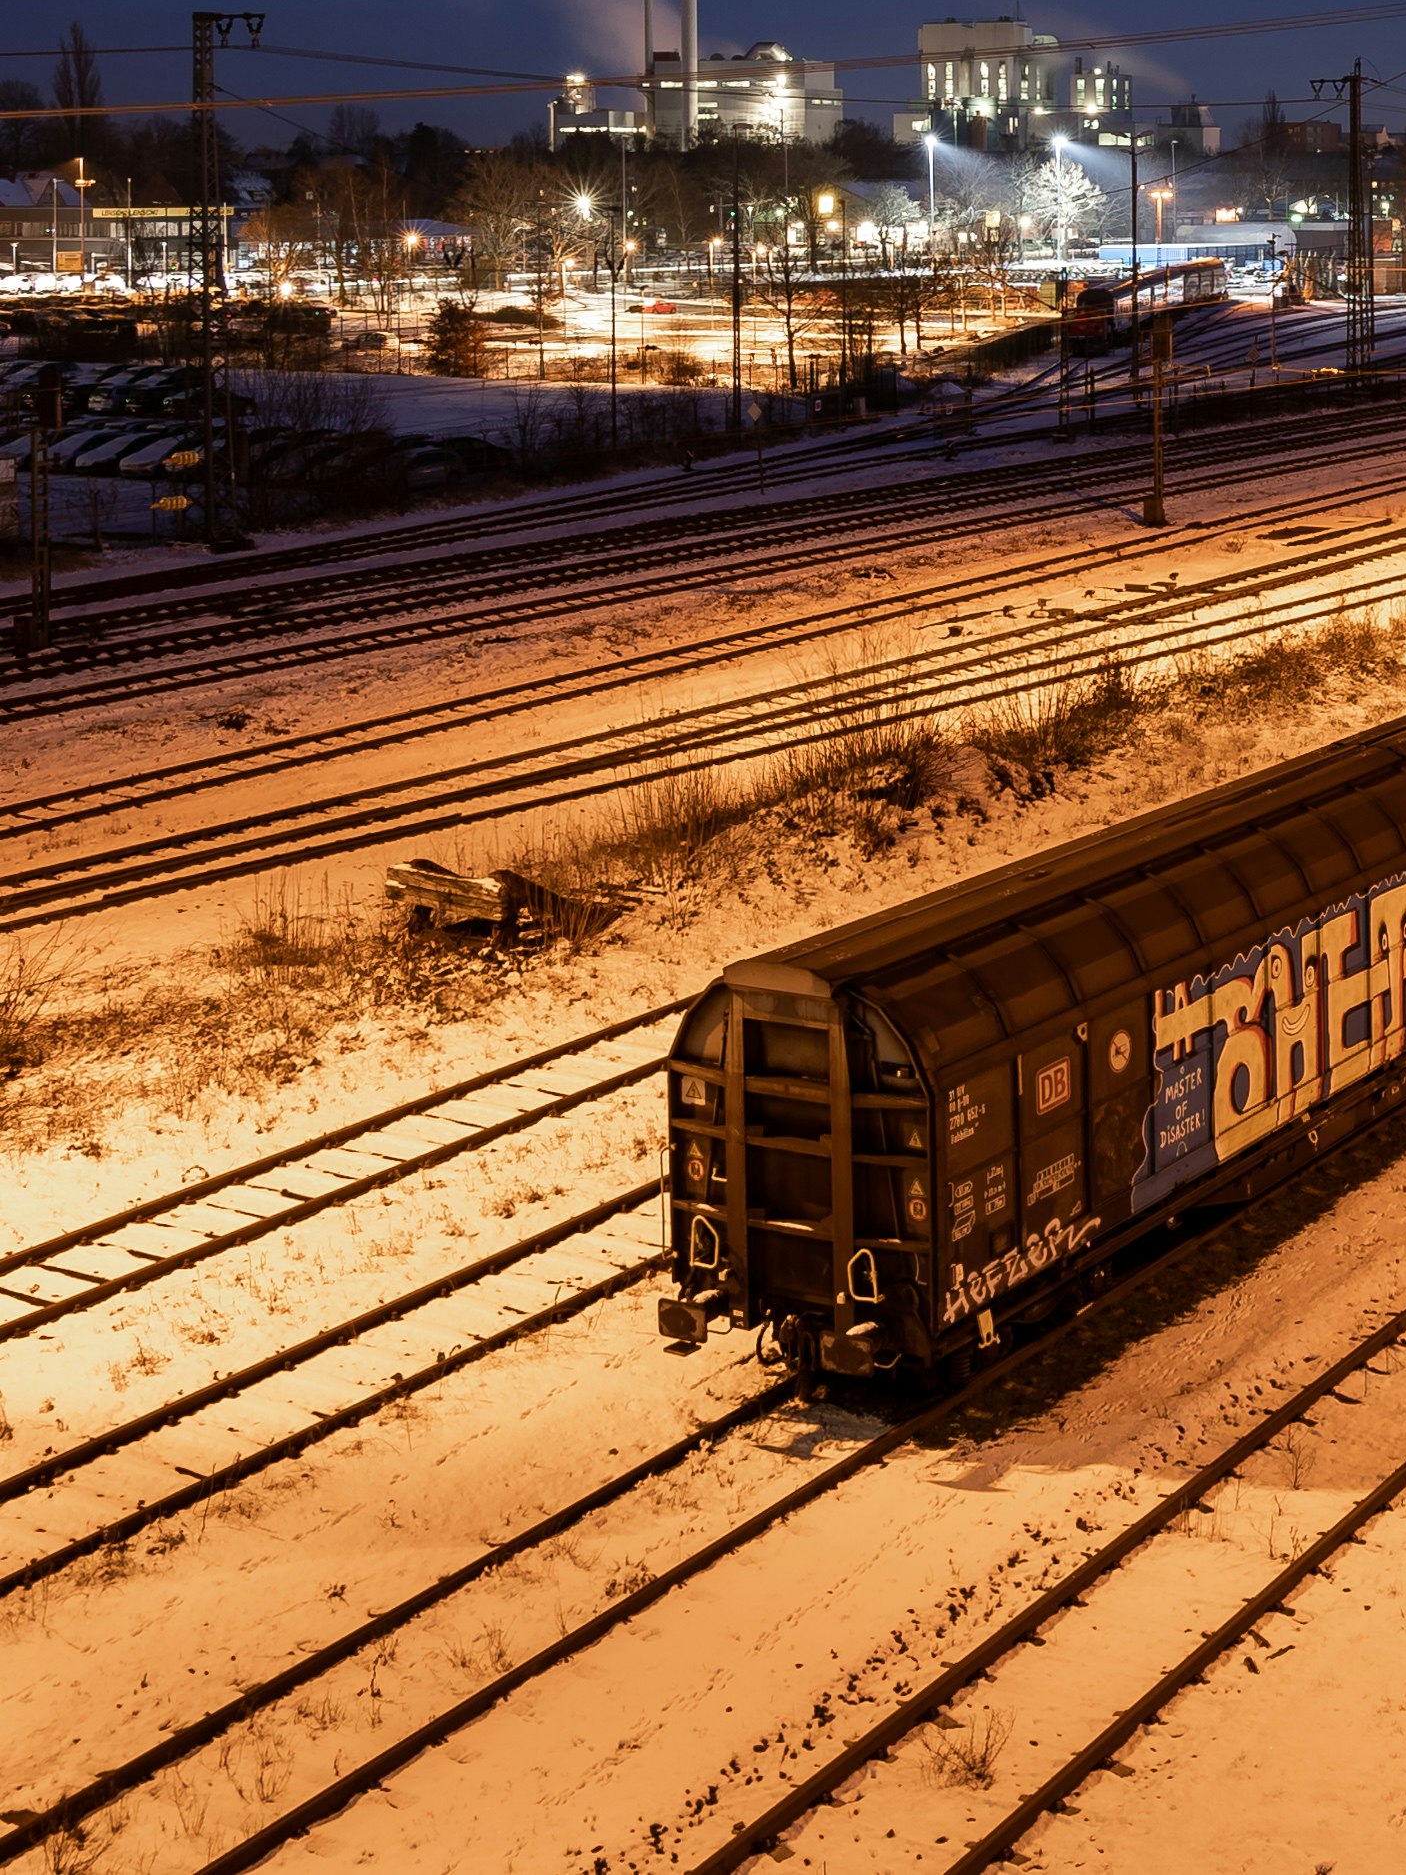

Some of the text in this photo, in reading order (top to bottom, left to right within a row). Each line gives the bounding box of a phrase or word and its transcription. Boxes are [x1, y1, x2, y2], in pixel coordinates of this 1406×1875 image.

[1040, 1066, 1067, 1107] DB
[1165, 1067, 1202, 1104] MASTER
[1175, 1100, 1188, 1120] OF
